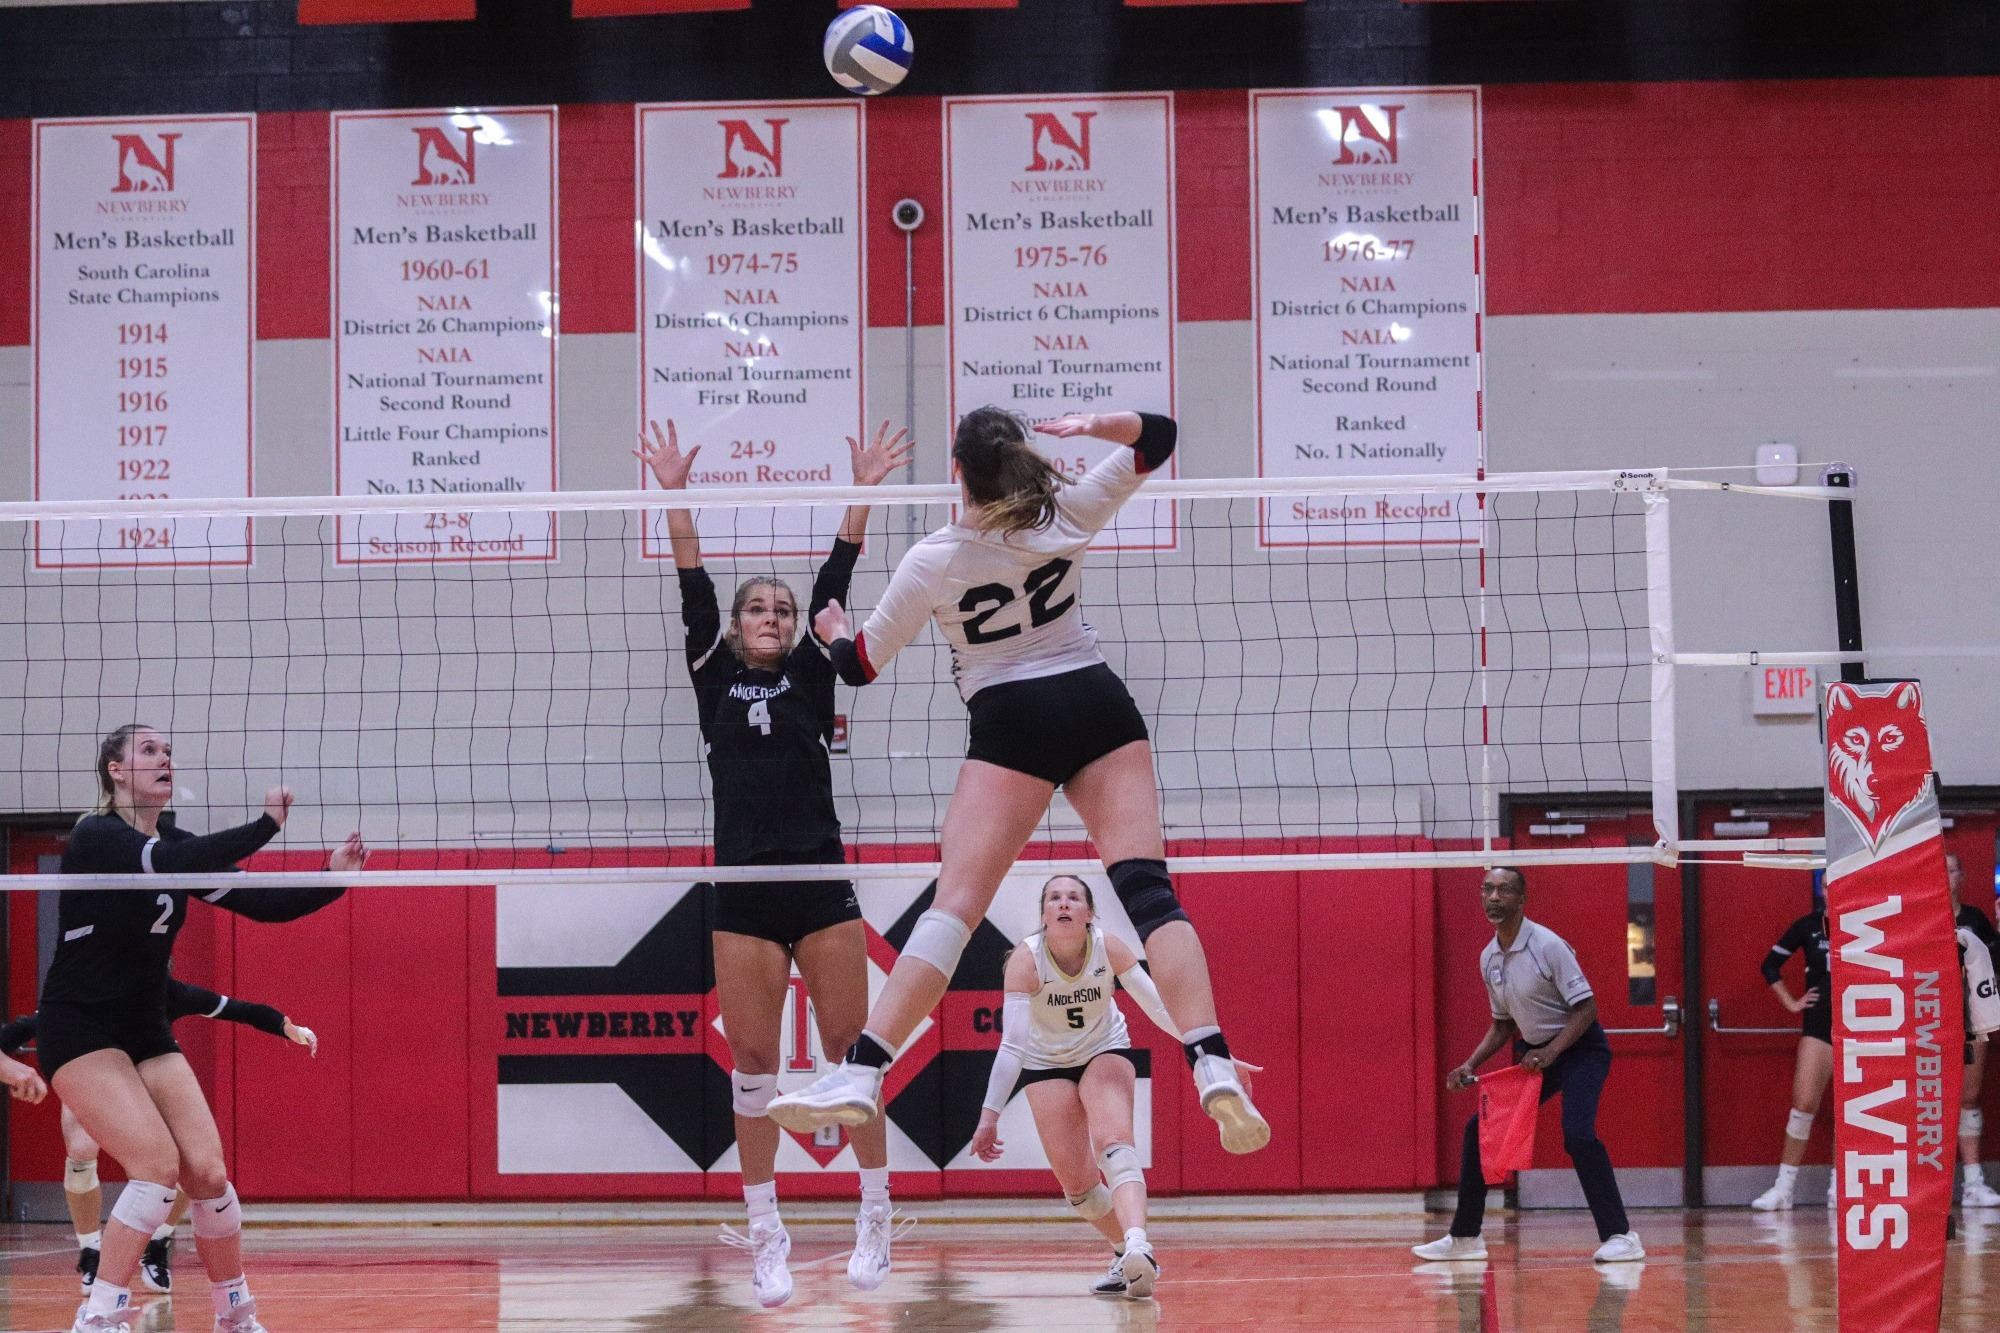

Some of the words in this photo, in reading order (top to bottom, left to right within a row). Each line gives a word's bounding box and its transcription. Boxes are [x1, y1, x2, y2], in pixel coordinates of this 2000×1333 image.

[1011, 179, 1107, 194] NEWBERRY
[1317, 173, 1415, 187] NEWBERRY
[397, 193, 491, 208] NEWBERRY
[703, 186, 798, 201] NEWBERRY
[97, 199, 190, 214] NEWBERRY
[1273, 206, 1338, 225] Men's
[1347, 204, 1459, 223] Basketball
[658, 219, 724, 238] Men's
[732, 216, 844, 236] Basketball
[966, 212, 1032, 231] Men's
[1040, 209, 1153, 229] Basketball
[53, 232, 117, 250] Men's
[125, 229, 234, 248] Basketball
[353, 226, 417, 245] Men's
[425, 223, 536, 243] Basketball
[1015, 245, 1107, 268] 1975-76
[1323, 239, 1415, 262] 1976-77
[78, 265, 130, 281] South
[134, 264, 210, 279] Carolina
[401, 258, 490, 281] 1960-61
[707, 252, 798, 275] 1974-75
[1033, 281, 1088, 298] NAIA
[1341, 276, 1396, 292] NAIA
[68, 289, 112, 304] State
[117, 287, 219, 307] Champions
[417, 295, 472, 312] NAIA
[725, 289, 779, 305] NAIA
[964, 306, 1032, 322] District
[1038, 306, 1049, 321] 6
[1054, 303, 1160, 324] Champions
[1271, 300, 1340, 316] District
[1346, 300, 1356, 314] 6
[1362, 298, 1467, 318] Champions
[344, 319, 410, 335] District
[416, 318, 436, 334] 26
[442, 316, 545, 337] Champions
[655, 313, 722, 329] District
[729, 313, 739, 327] 6
[744, 311, 849, 331] Champions
[117, 324, 168, 344] 1914
[1034, 335, 1089, 351] NAIA
[1342, 329, 1397, 345] NAIA
[418, 347, 472, 364] NAIA
[725, 341, 779, 357] NAIA
[117, 358, 168, 379] 1915
[962, 360, 1042, 377] National
[1047, 359, 1162, 375] Tournament
[1269, 354, 1349, 371] National
[1355, 353, 1470, 369] Tournament
[348, 372, 426, 389] National
[432, 371, 543, 387] Tournament
[654, 366, 732, 383] National
[738, 365, 852, 381] Tournament
[1012, 383, 1055, 399] Elite
[1061, 381, 1113, 402] Eight
[1303, 378, 1369, 394] Second
[1376, 376, 1437, 392] Round
[117, 392, 168, 413] 1916
[379, 396, 444, 412] Second
[451, 394, 511, 410] Round
[698, 390, 740, 406] First
[746, 388, 807, 404] Round
[1336, 415, 1406, 431] Ranked
[117, 426, 168, 446] 1917
[344, 426, 391, 442] Little
[397, 425, 439, 441] Four
[445, 423, 549, 444] Champions
[412, 450, 480, 466] Ranked
[730, 440, 776, 459] 24-9
[1295, 444, 1329, 460] No.
[1336, 444, 1344, 459] 1
[1350, 442, 1446, 462] Nationally
[117, 460, 170, 481] 1922
[687, 467, 748, 484] eason
[756, 464, 831, 482] Record
[1053, 457, 1086, 476] 0-5
[367, 479, 400, 495] No.
[407, 479, 424, 494] 13
[431, 477, 525, 493] Nationally
[1293, 501, 1366, 520] Season
[1375, 500, 1451, 519] Record
[424, 512, 469, 529] 23-8
[118, 528, 170, 549] 1924
[369, 536, 441, 554] Season
[450, 534, 524, 552] Record
[959, 557, 1075, 644] 22
[1765, 668, 1807, 699] EXIT
[747, 700, 771, 736] 4
[150, 893, 174, 934] 2
[1047, 986, 1102, 1007] ANDERSON
[506, 1011, 699, 1039] NEWBERRY
[1066, 1007, 1085, 1029] 5
[1839, 895, 1909, 1251] WOLVES
[1913, 971, 1944, 1171] NEWBERRY
